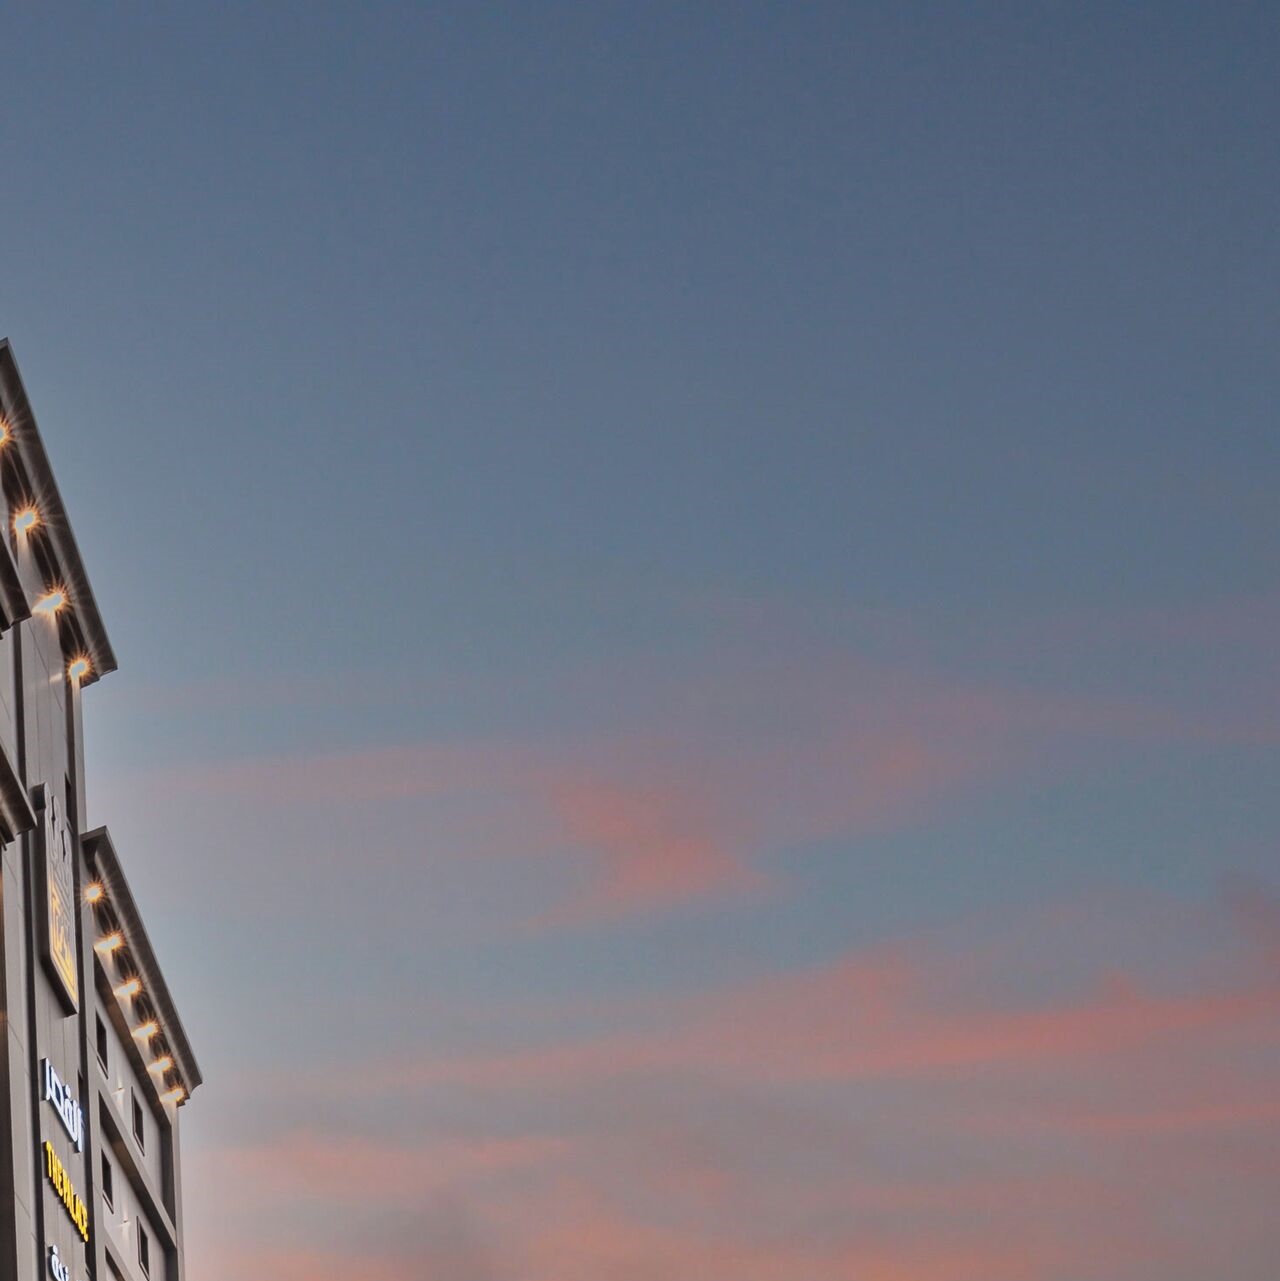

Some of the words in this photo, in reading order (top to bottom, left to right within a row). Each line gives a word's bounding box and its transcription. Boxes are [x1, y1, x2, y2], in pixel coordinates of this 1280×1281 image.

[46, 1058, 83, 1153] القصر
[46, 1140, 63, 1198] THE
[62, 1168, 89, 1243] PALACE
